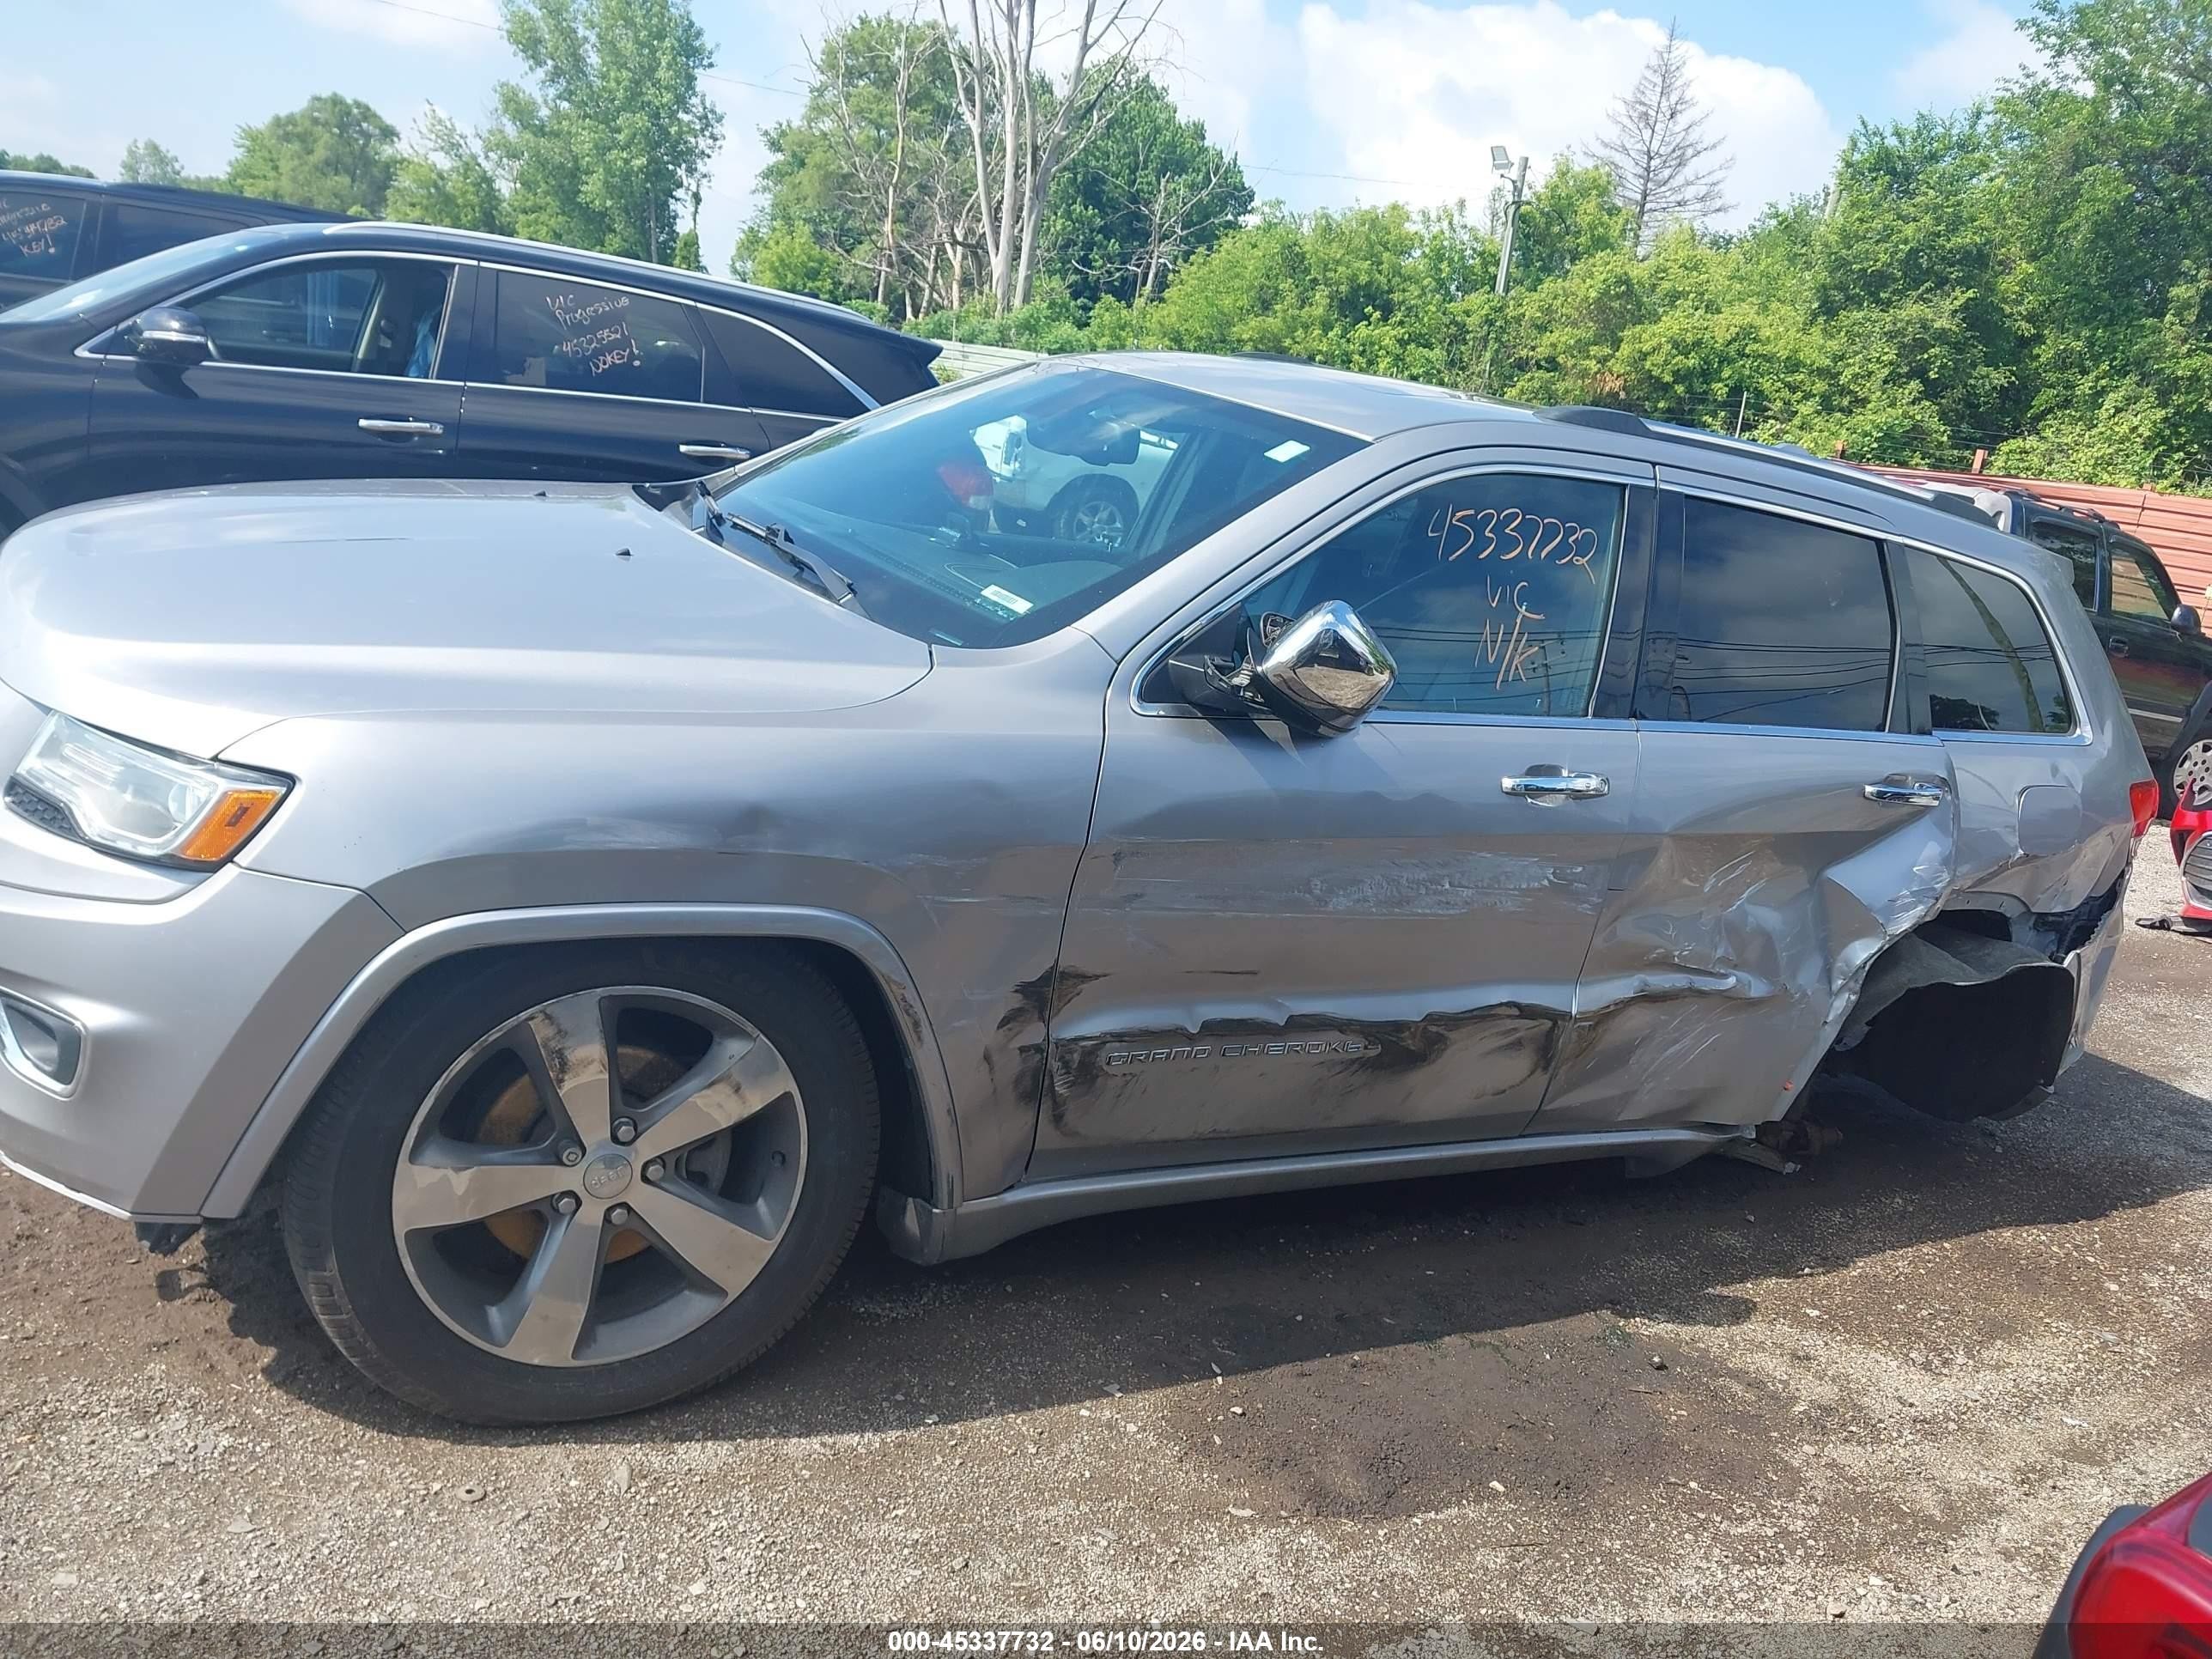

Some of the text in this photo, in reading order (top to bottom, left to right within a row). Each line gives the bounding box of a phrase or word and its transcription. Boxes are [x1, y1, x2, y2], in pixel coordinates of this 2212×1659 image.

[562, 321, 629, 357] 45325521
[1427, 504, 1598, 585] 45337732
[1105, 1045, 1212, 1066] GRAND
